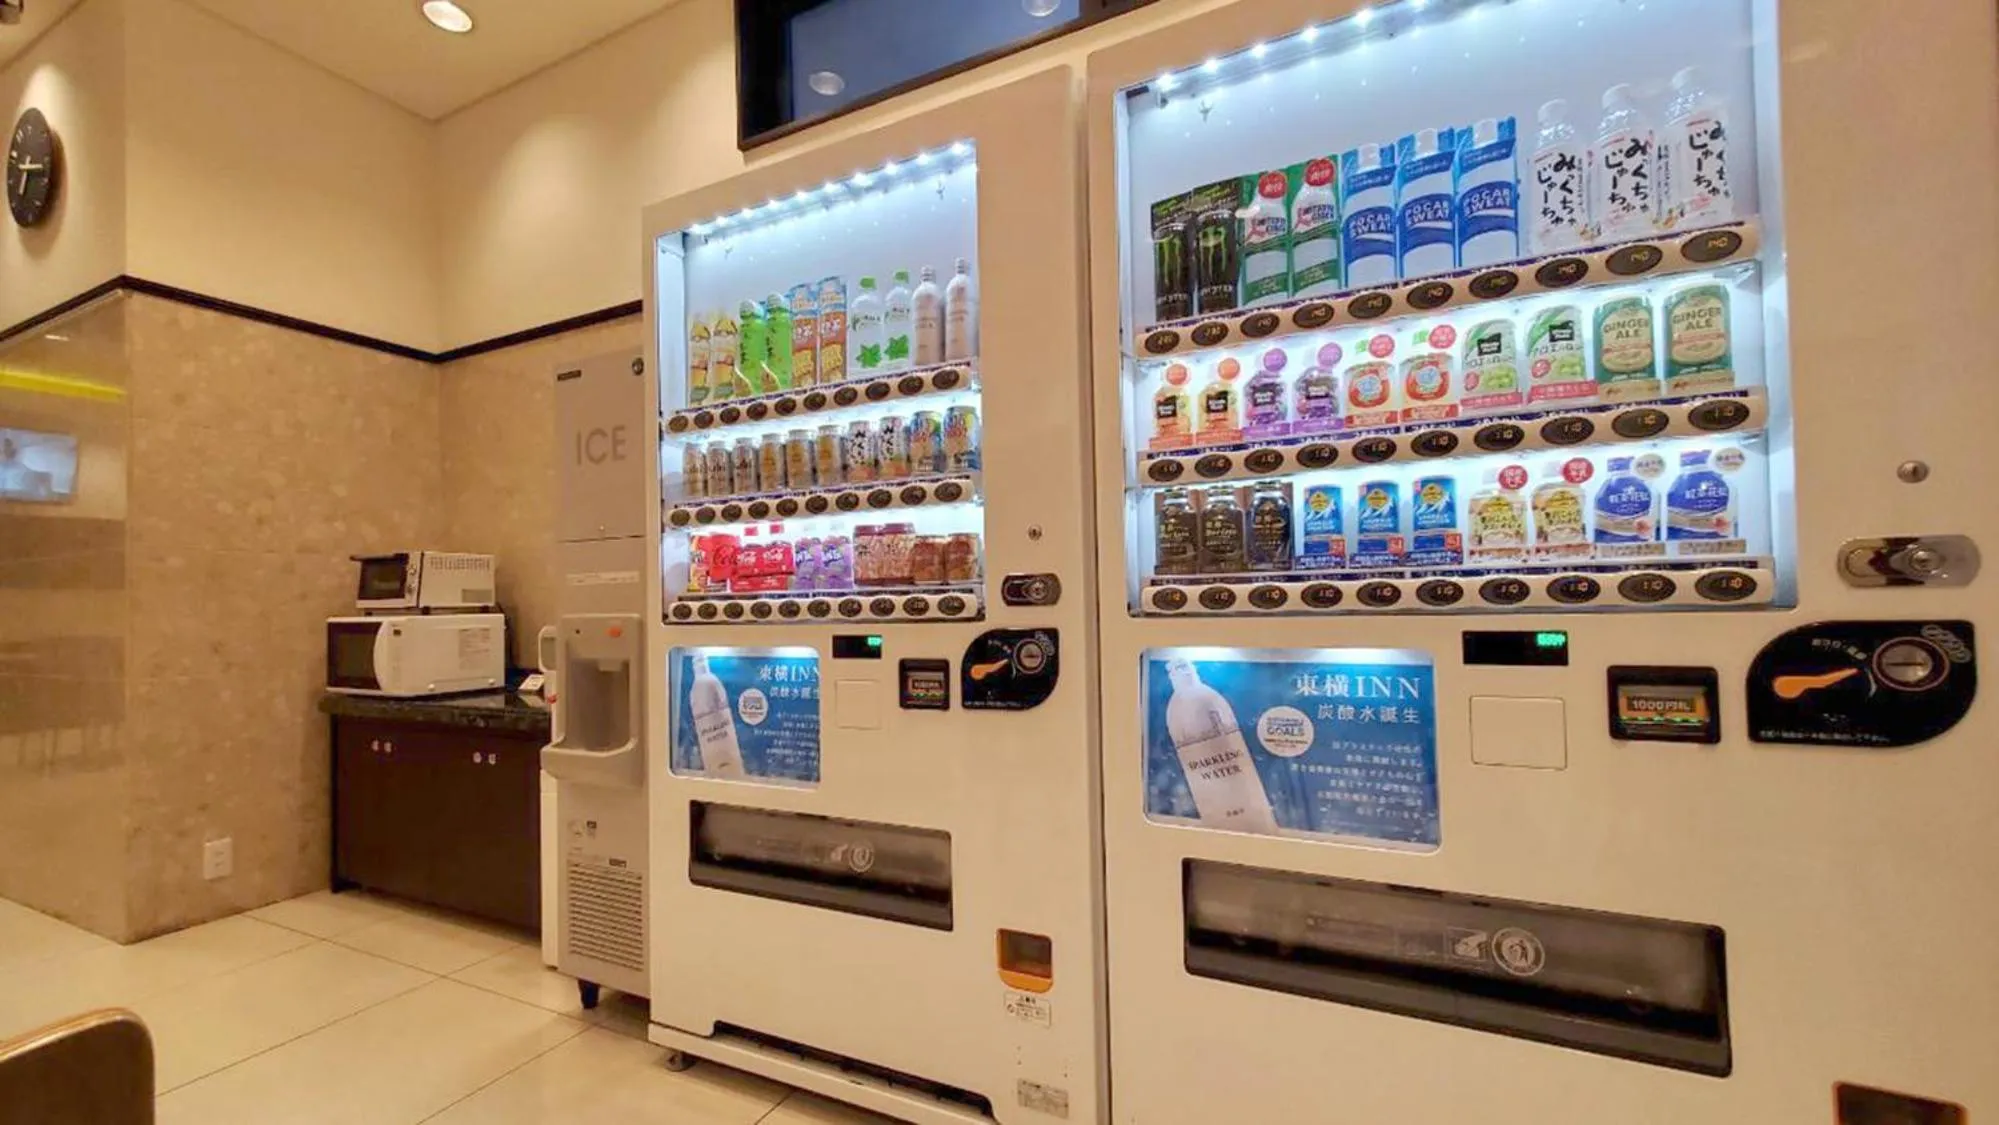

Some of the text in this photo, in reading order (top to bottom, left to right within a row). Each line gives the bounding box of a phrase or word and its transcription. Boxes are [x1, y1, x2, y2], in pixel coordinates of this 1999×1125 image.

[1685, 319, 1713, 330] ALE
[1616, 330, 1641, 340] ALE
[576, 425, 627, 466] ICE
[1317, 704, 1420, 724] 炭酸水誕生
[1201, 765, 1241, 780] WATER
